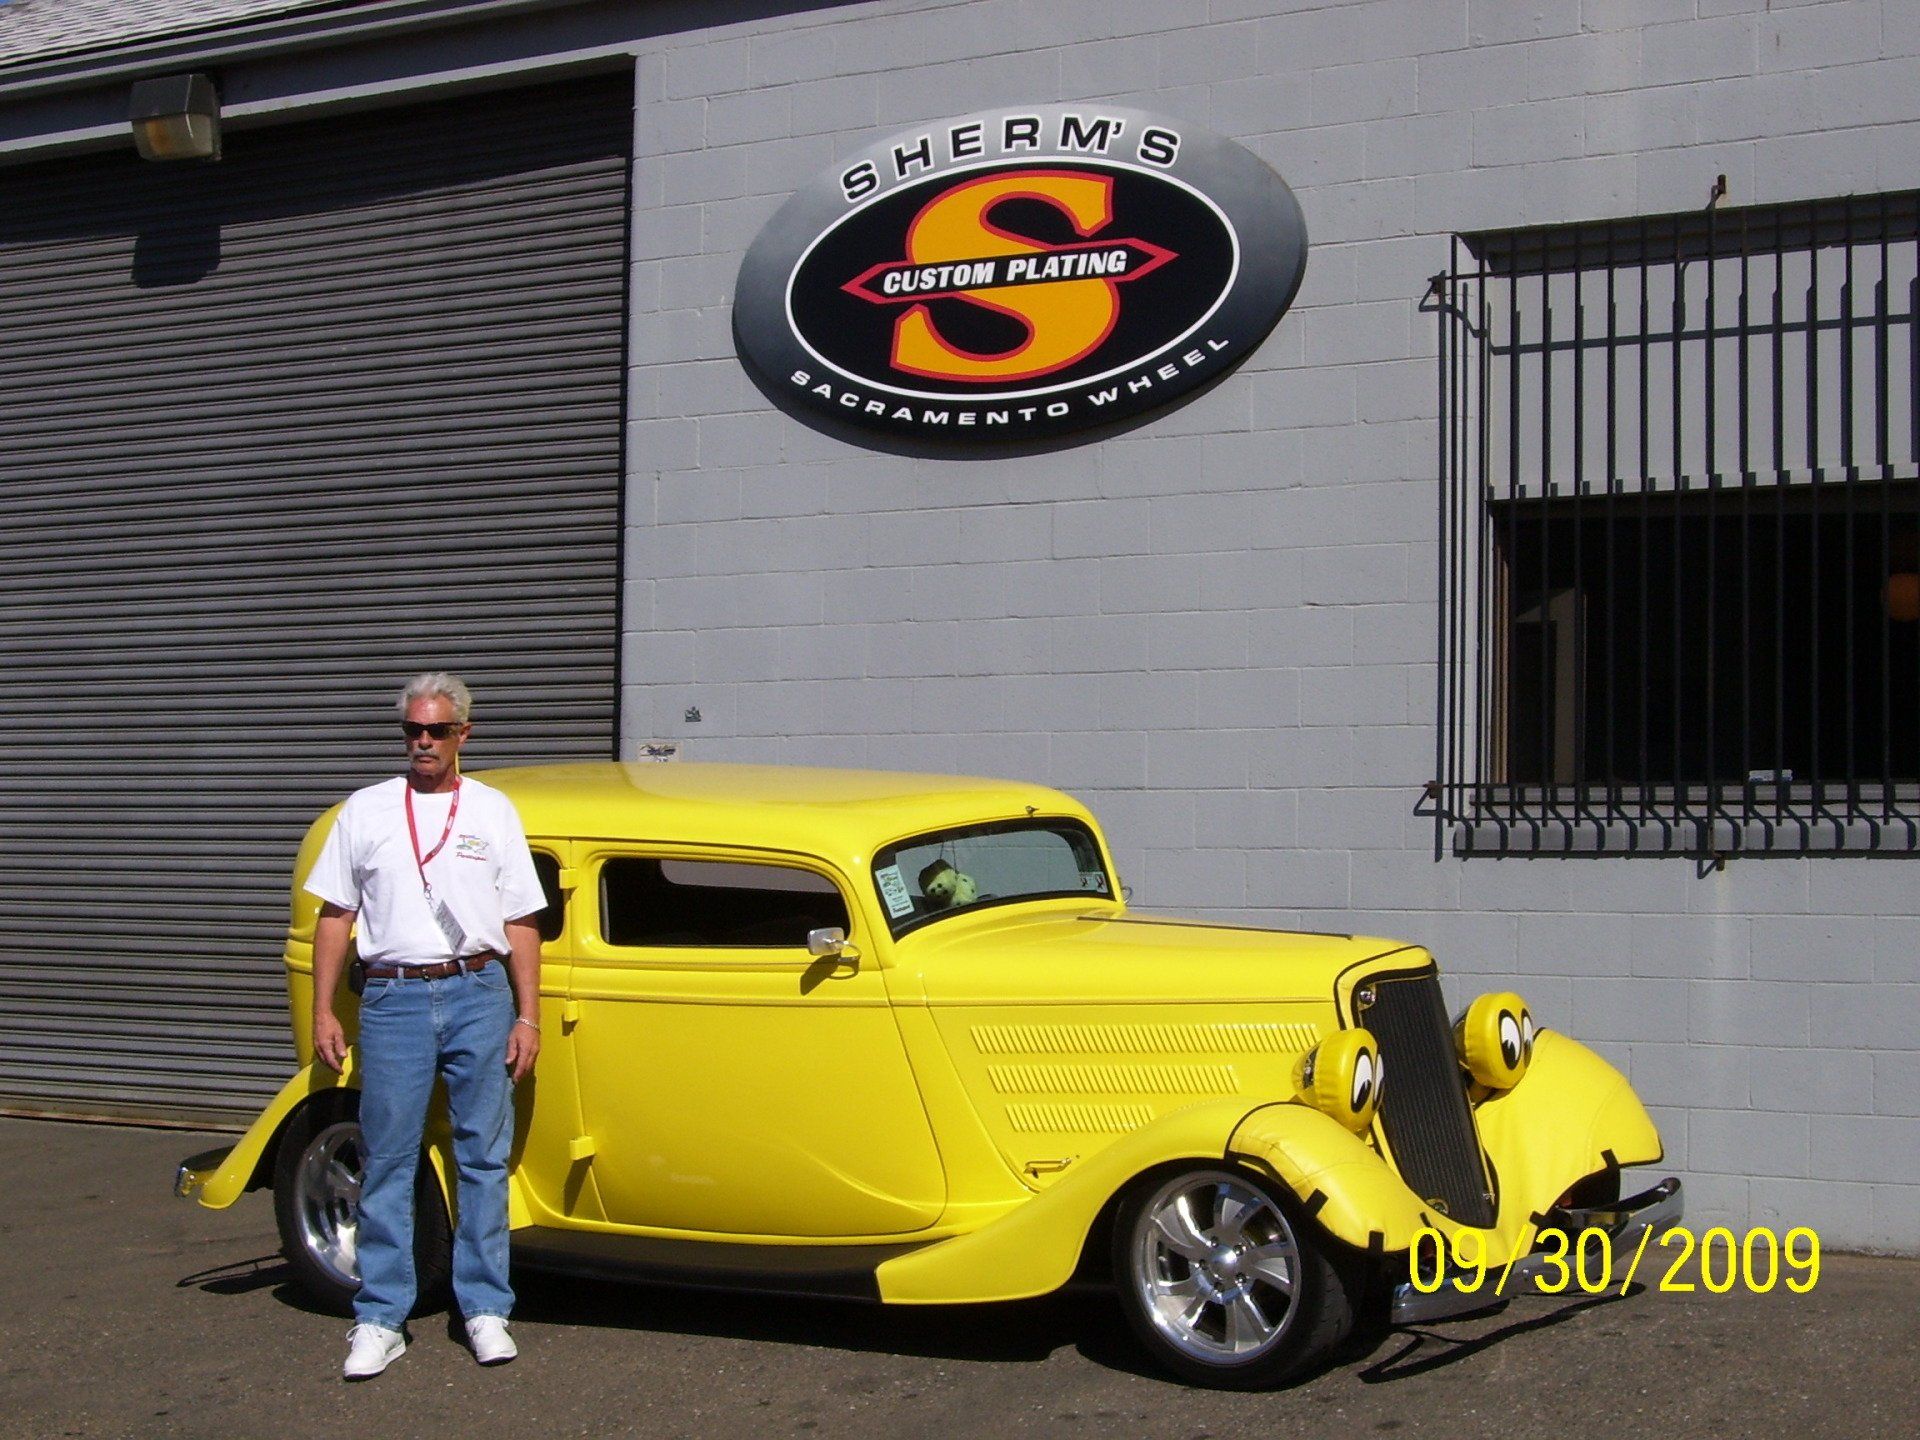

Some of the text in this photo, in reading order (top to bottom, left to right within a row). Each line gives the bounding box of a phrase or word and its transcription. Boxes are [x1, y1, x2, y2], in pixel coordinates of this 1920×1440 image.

[841, 114, 1181, 202] SHERM'S
[883, 250, 1127, 294] CUSTOM PLATING
[890, 170, 1120, 383] S
[790, 336, 1230, 426] SACRAMENTO WHEEL
